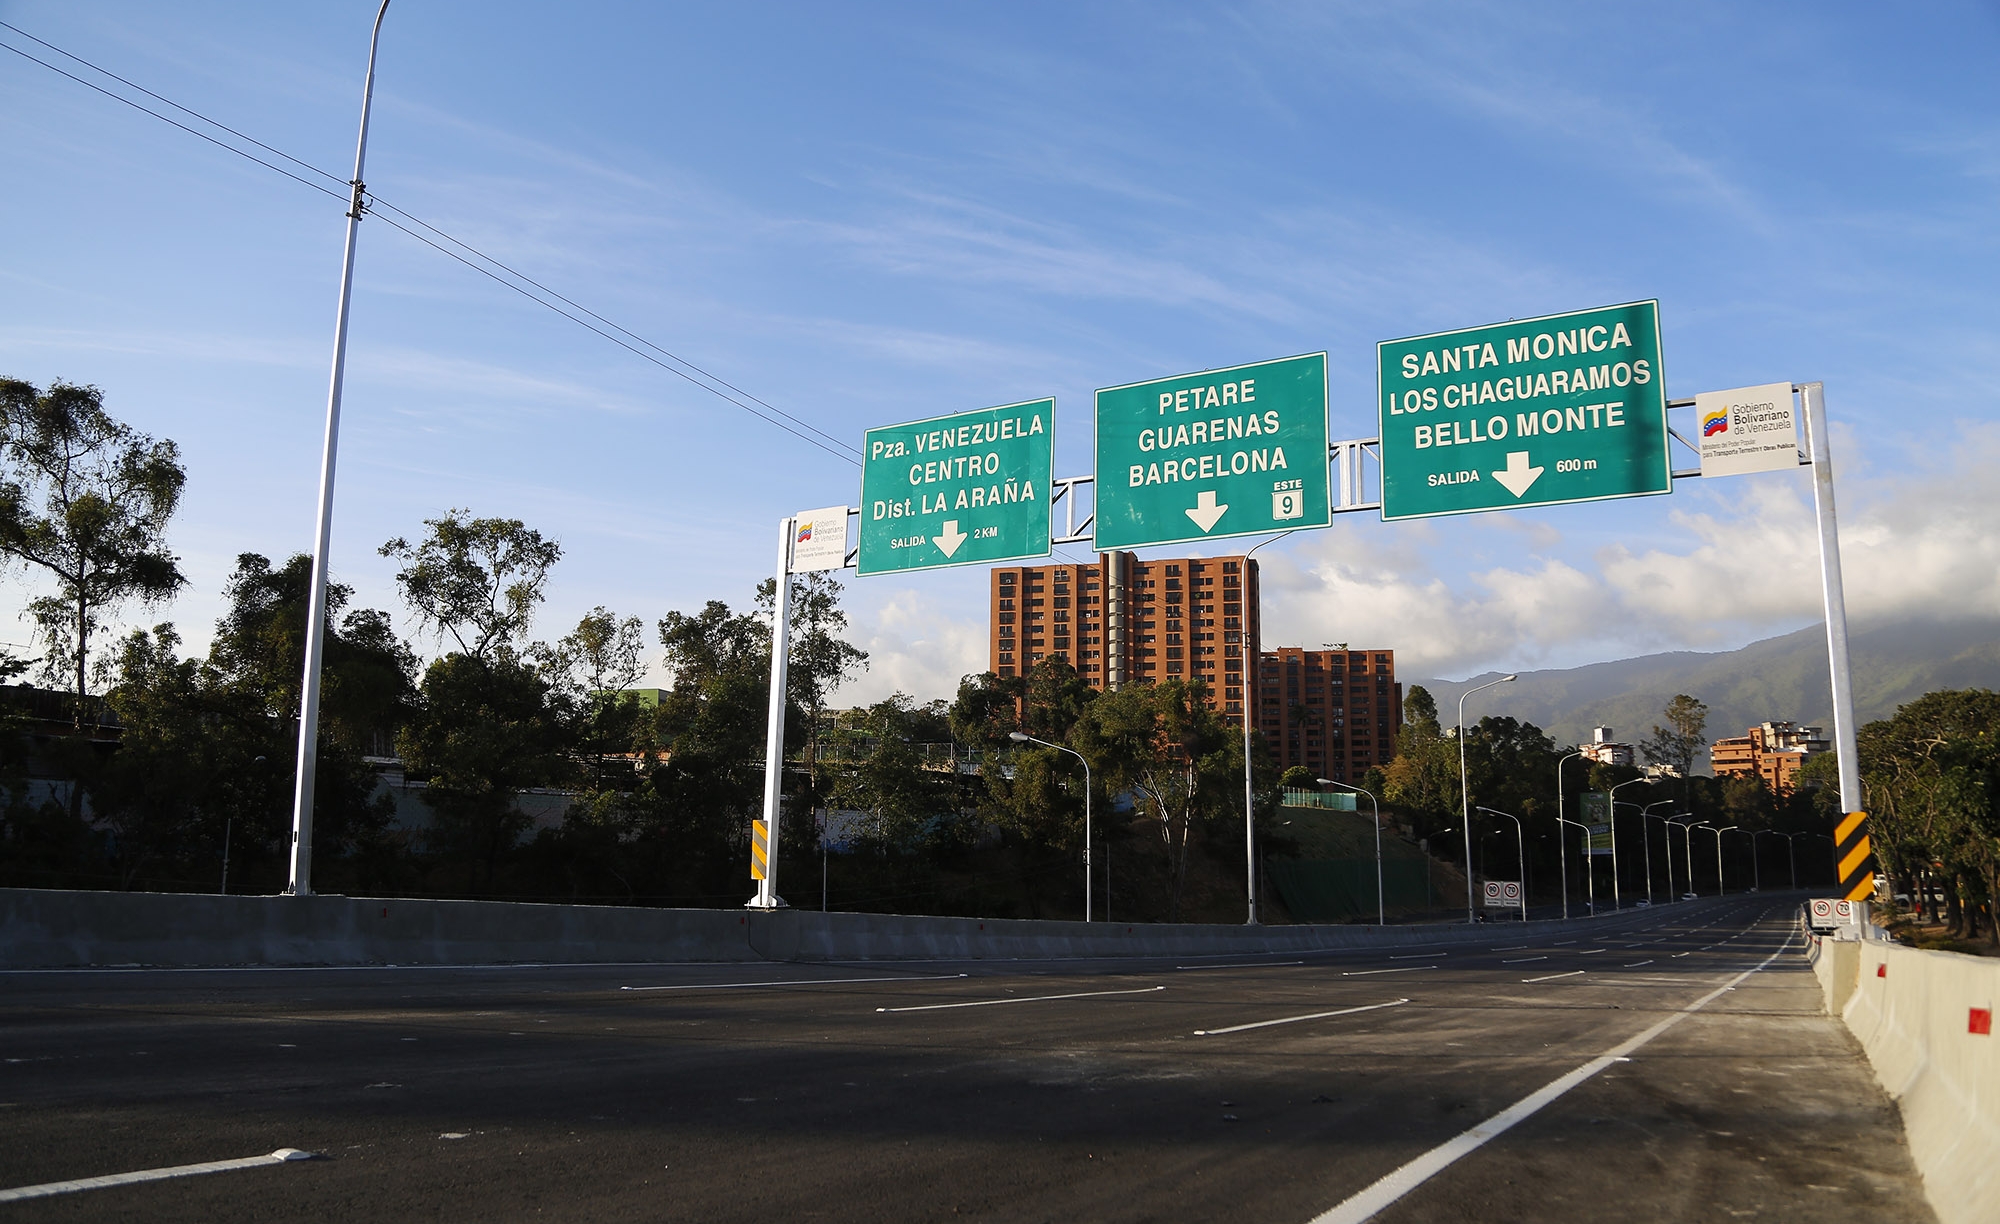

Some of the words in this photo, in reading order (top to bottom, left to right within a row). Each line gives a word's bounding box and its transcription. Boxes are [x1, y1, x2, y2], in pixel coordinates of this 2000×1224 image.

[1401, 342, 1499, 379] SANTA
[1507, 322, 1632, 364] MONICA
[1158, 379, 1256, 416] PETARE
[1390, 387, 1438, 416] LOS
[1443, 359, 1651, 409] CHAGUARAMOS
[1414, 415, 1508, 449] BELLO
[1516, 401, 1625, 437] MONTE
[1732, 402, 1774, 415] Gobierno
[1734, 410, 1789, 425] Bolivariano
[872, 441, 910, 461] Pza.
[915, 414, 1044, 454] VENEZUELA
[1138, 410, 1280, 452] GUARENAS
[1734, 425, 1745, 435] de
[1747, 420, 1791, 433] Venezuela
[909, 452, 1000, 486] CENTRO
[1129, 446, 1288, 488] BARCELONA
[1427, 469, 1480, 487] SALIDA
[1556, 459, 1581, 473] 600
[1584, 459, 1597, 470] m
[873, 498, 916, 521] Dist.
[921, 492, 947, 515] LA
[954, 477, 1035, 510] ARAÑA
[1273, 479, 1302, 491] ESTE
[1282, 496, 1293, 514] 9
[890, 535, 926, 549] SALIDA
[974, 529, 980, 539] 2
